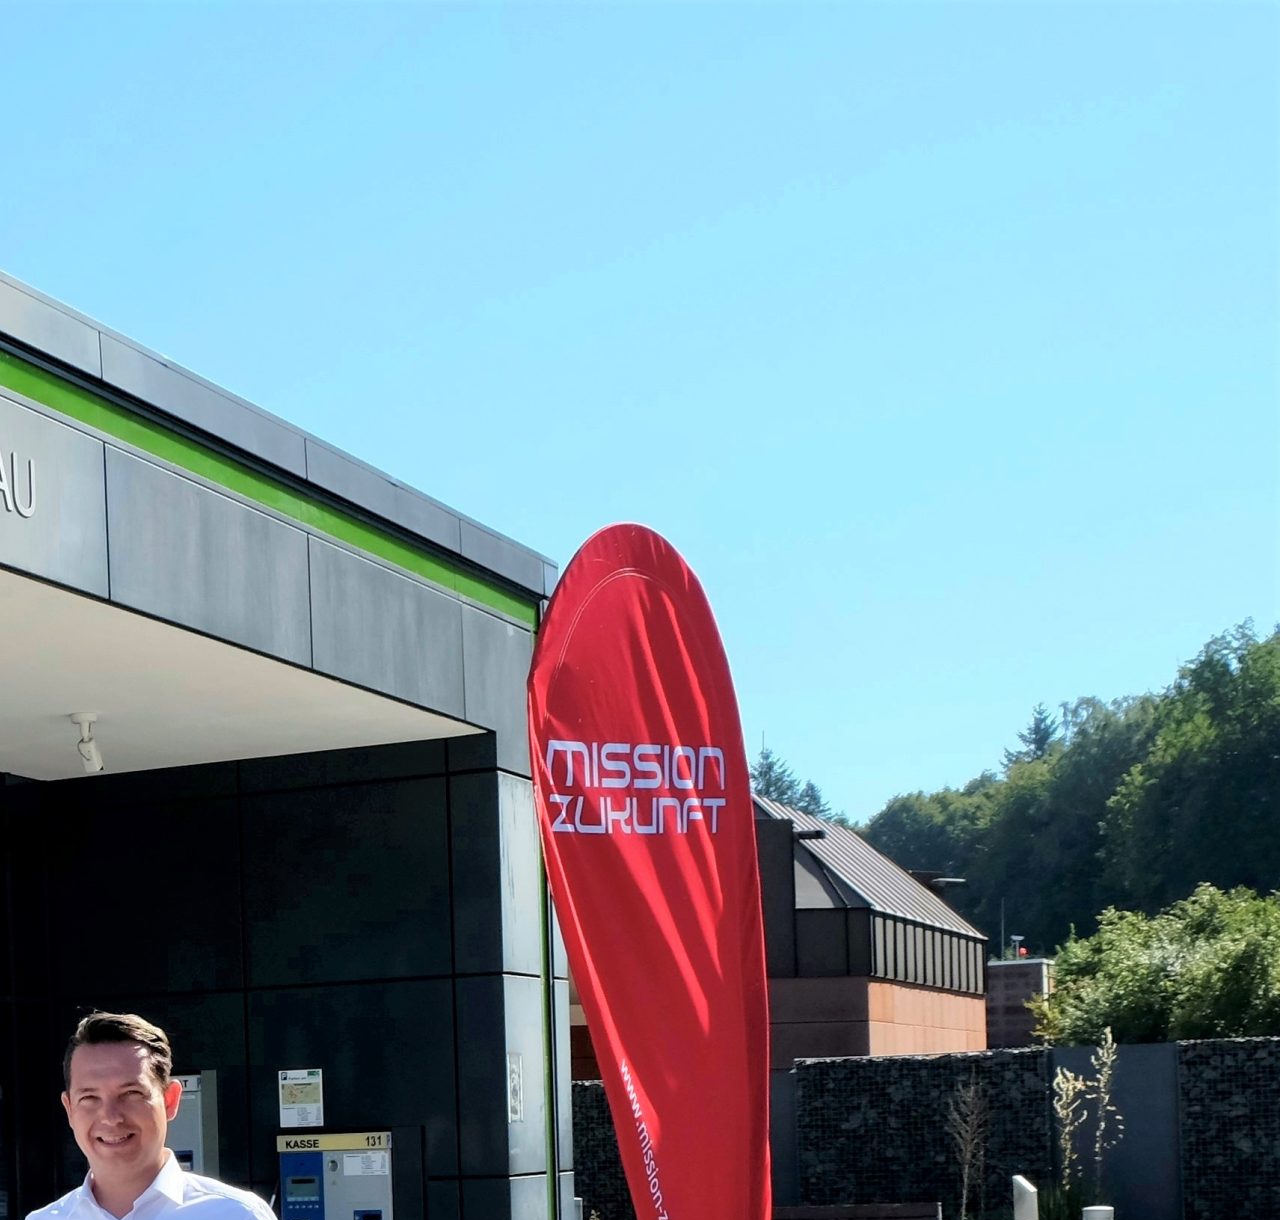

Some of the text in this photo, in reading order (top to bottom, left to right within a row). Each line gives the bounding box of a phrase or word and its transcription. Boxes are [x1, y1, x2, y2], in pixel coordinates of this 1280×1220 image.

[546, 740, 726, 790] MISSION
[549, 794, 726, 834] ZUKUNFT
[285, 1139, 320, 1149] KASSE
[366, 1135, 382, 1147] 131
